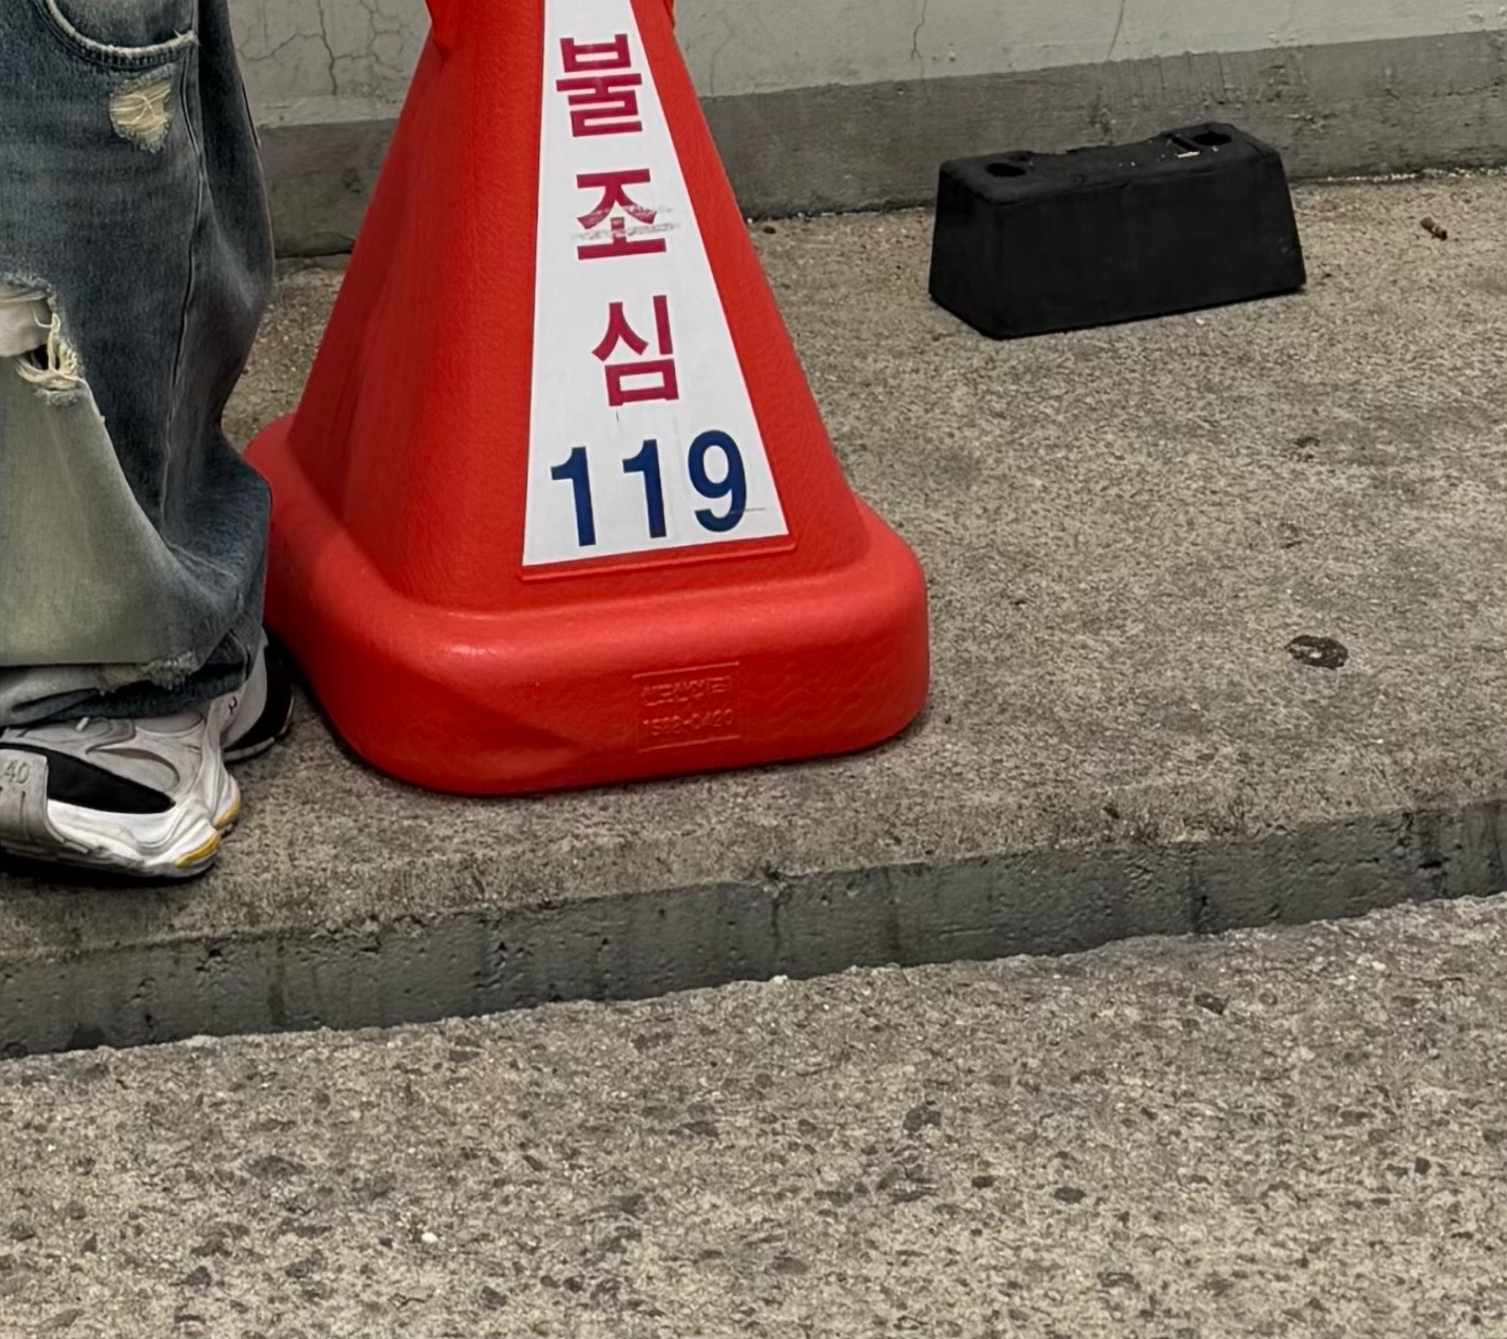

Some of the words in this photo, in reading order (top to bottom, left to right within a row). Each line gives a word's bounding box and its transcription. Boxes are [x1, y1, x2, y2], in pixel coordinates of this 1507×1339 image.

[556, 33, 679, 406] 불조심
[550, 429, 748, 547] 119
[3, 761, 31, 784] 40
